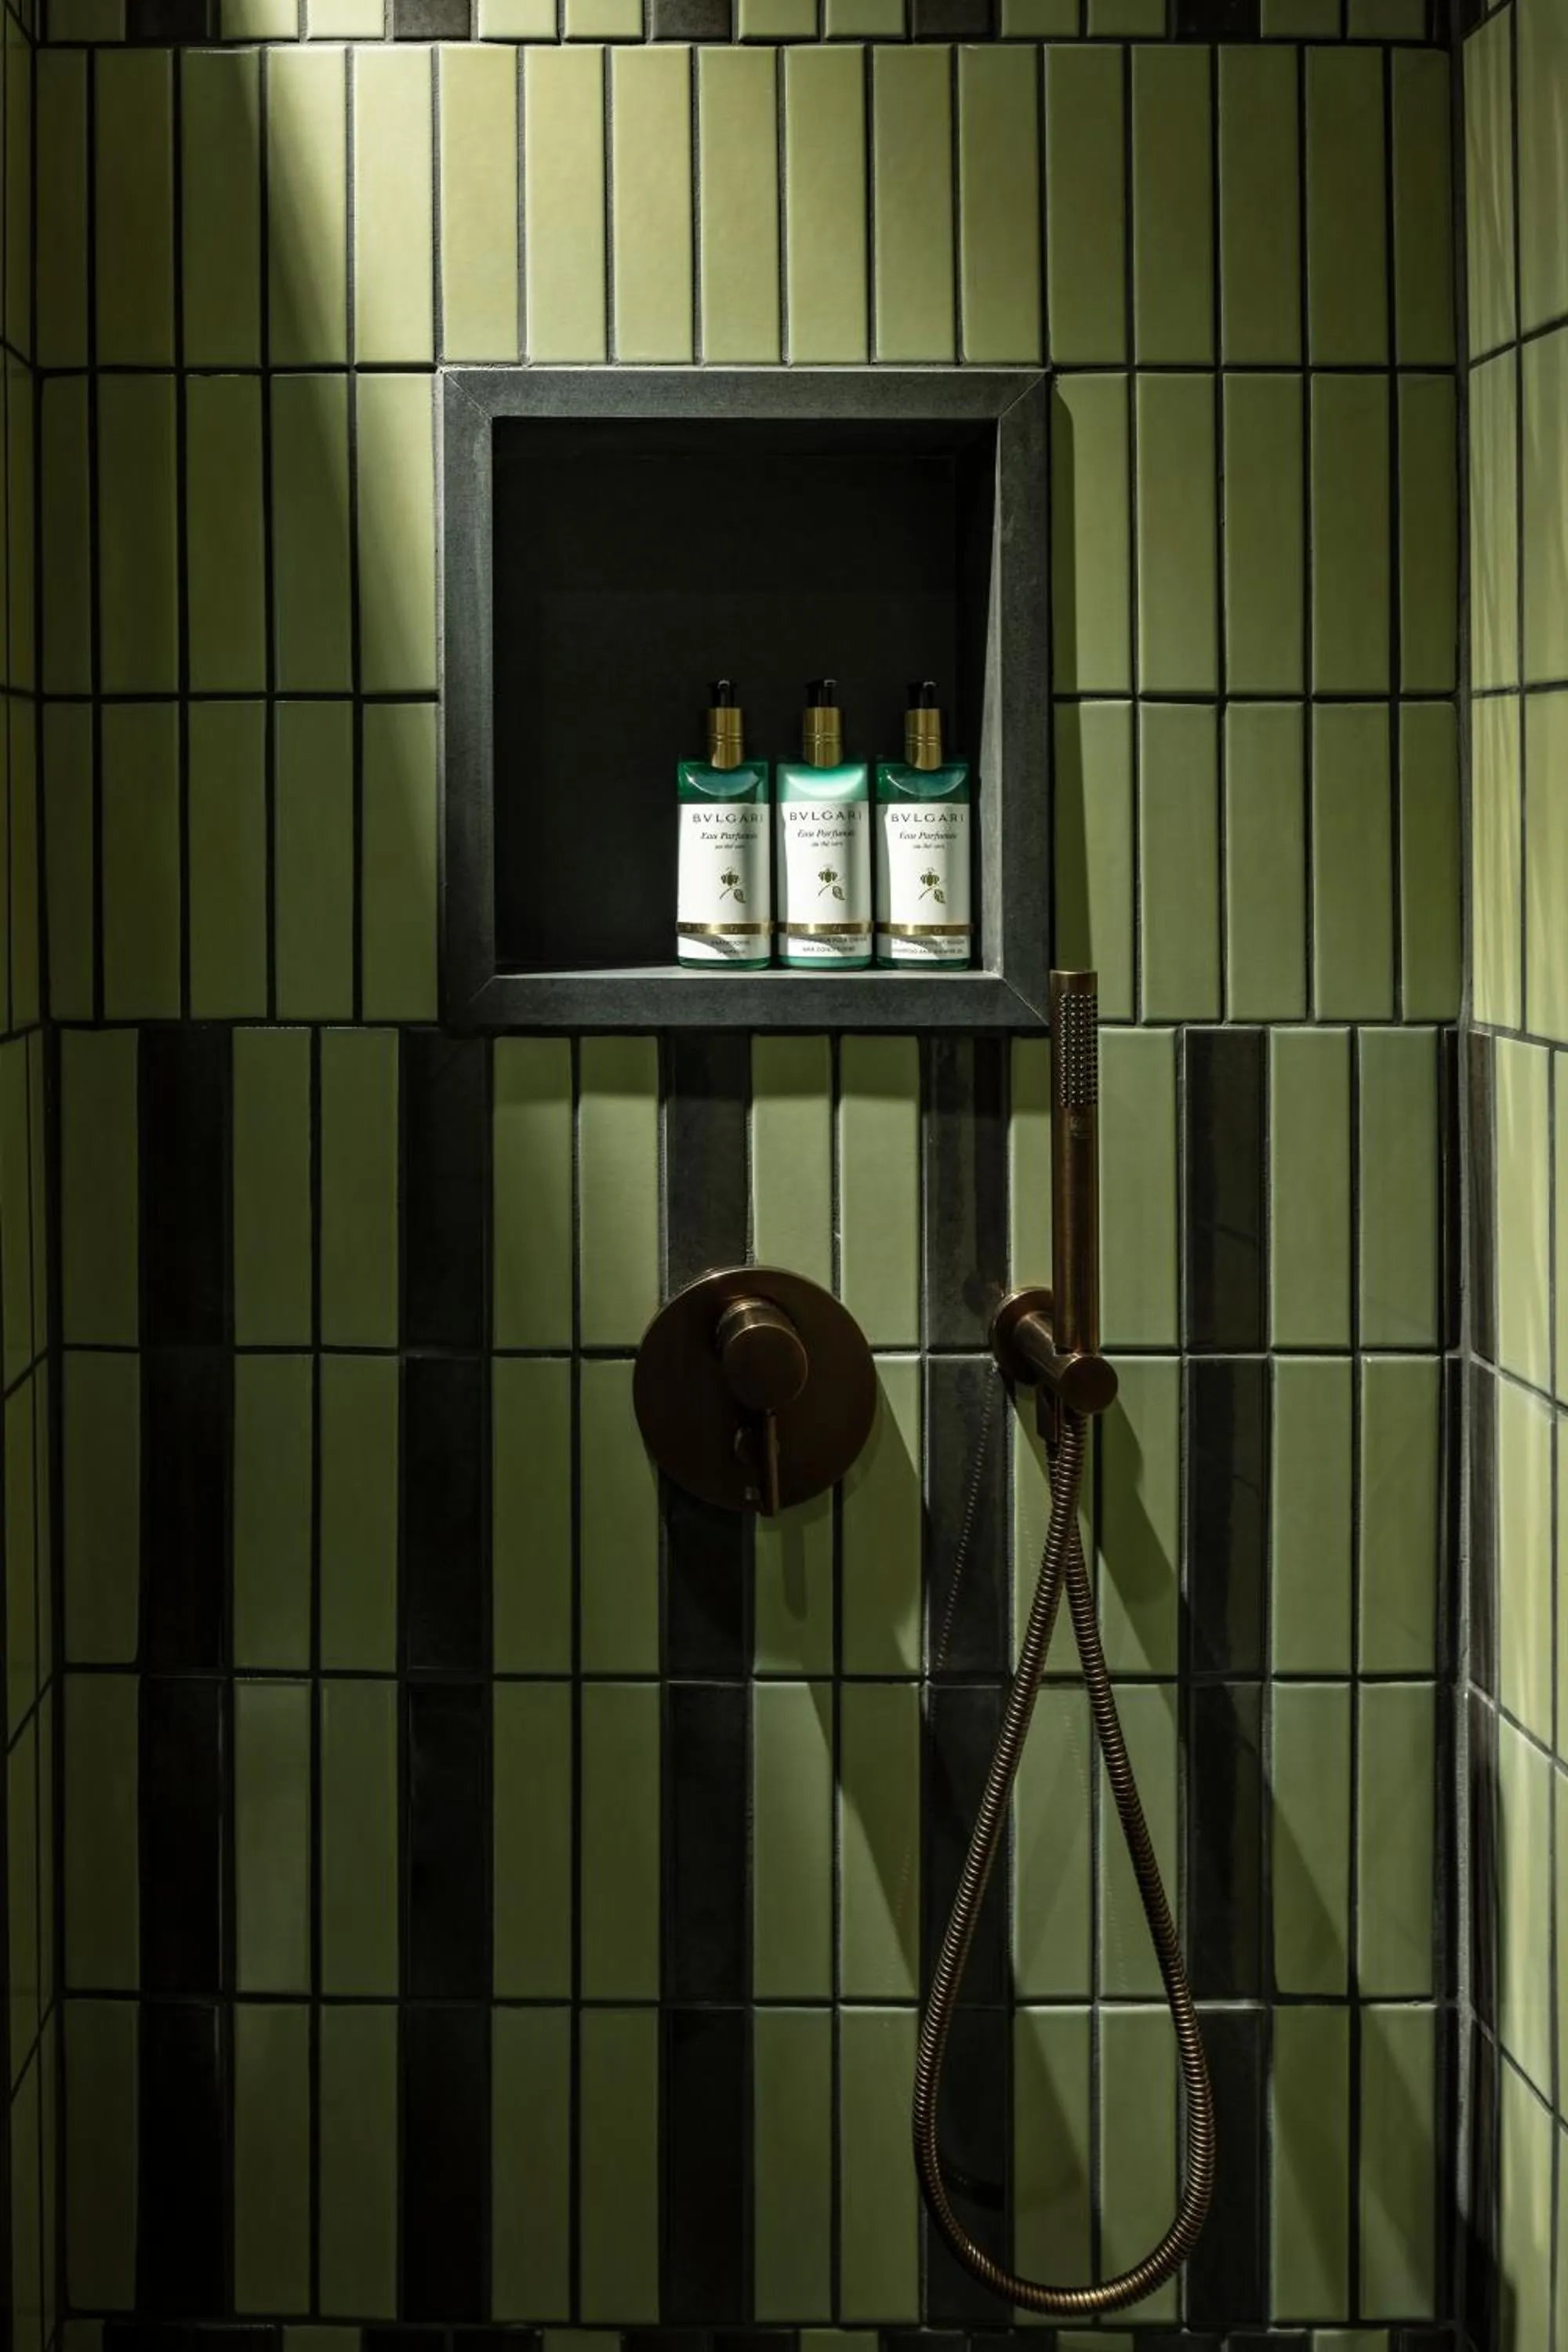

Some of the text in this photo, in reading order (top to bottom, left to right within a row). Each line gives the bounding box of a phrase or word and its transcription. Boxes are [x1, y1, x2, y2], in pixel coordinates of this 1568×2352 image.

[692, 813, 764, 823] BVLGARI
[789, 811, 862, 821] BVLGARI
[891, 813, 964, 822] BVLGARI
